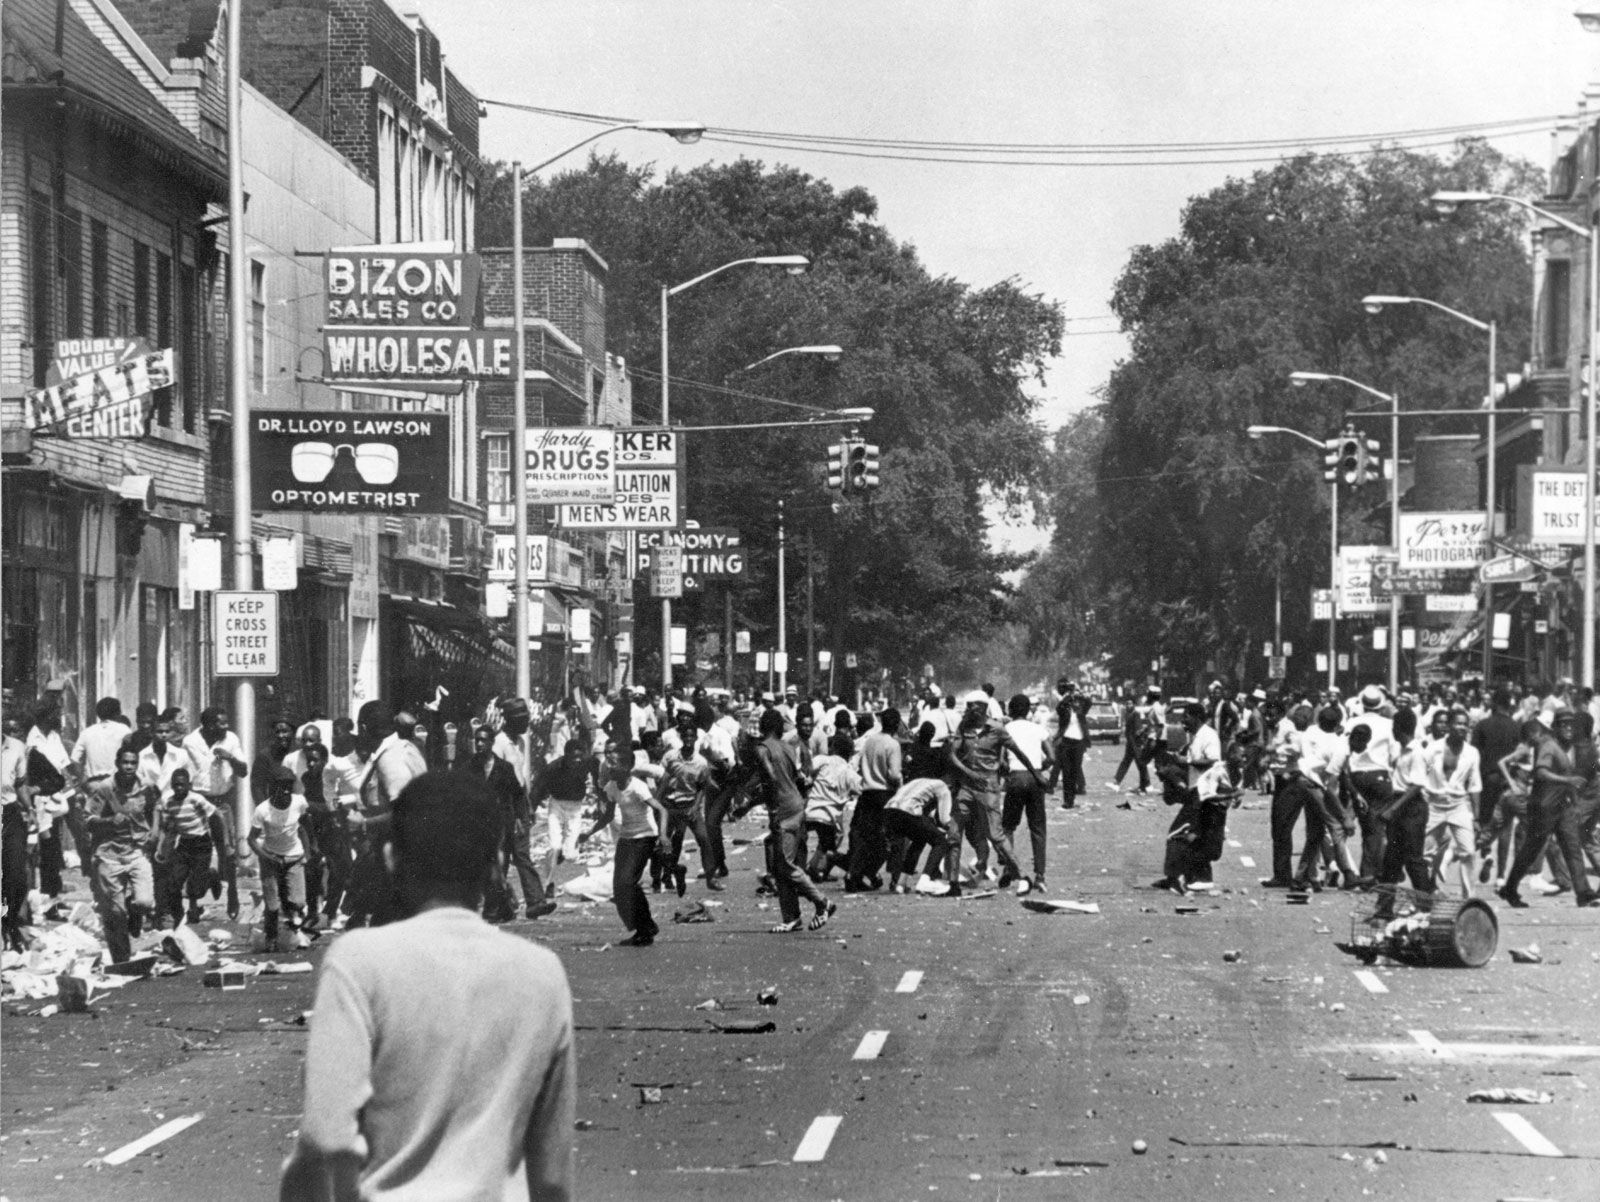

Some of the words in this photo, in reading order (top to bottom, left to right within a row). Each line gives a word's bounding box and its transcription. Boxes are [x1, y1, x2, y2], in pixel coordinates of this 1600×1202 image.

[329, 258, 462, 296] BIZON
[328, 299, 410, 319] SALES
[421, 301, 457, 320] CO
[58, 338, 126, 357] DOUBLE
[327, 336, 511, 375] WHOLESALE
[56, 352, 116, 380] VALUE
[25, 350, 171, 430] MEATS
[67, 398, 144, 437] CENTER
[258, 419, 286, 433] DR.
[288, 420, 346, 434] LLOYD
[353, 421, 431, 436] LAWSON
[535, 430, 595, 451] Hardy
[525, 450, 610, 471] DRUGS
[525, 473, 609, 481] PRESCRIPTIONS
[1539, 481, 1558, 496] THE
[271, 490, 420, 507] OPTOMETRIST
[623, 506, 672, 522] WEAR
[229, 601, 264, 613] KEEP
[226, 618, 266, 631] CROSS
[226, 635, 268, 648] STREET
[227, 652, 266, 665] CLEAR
